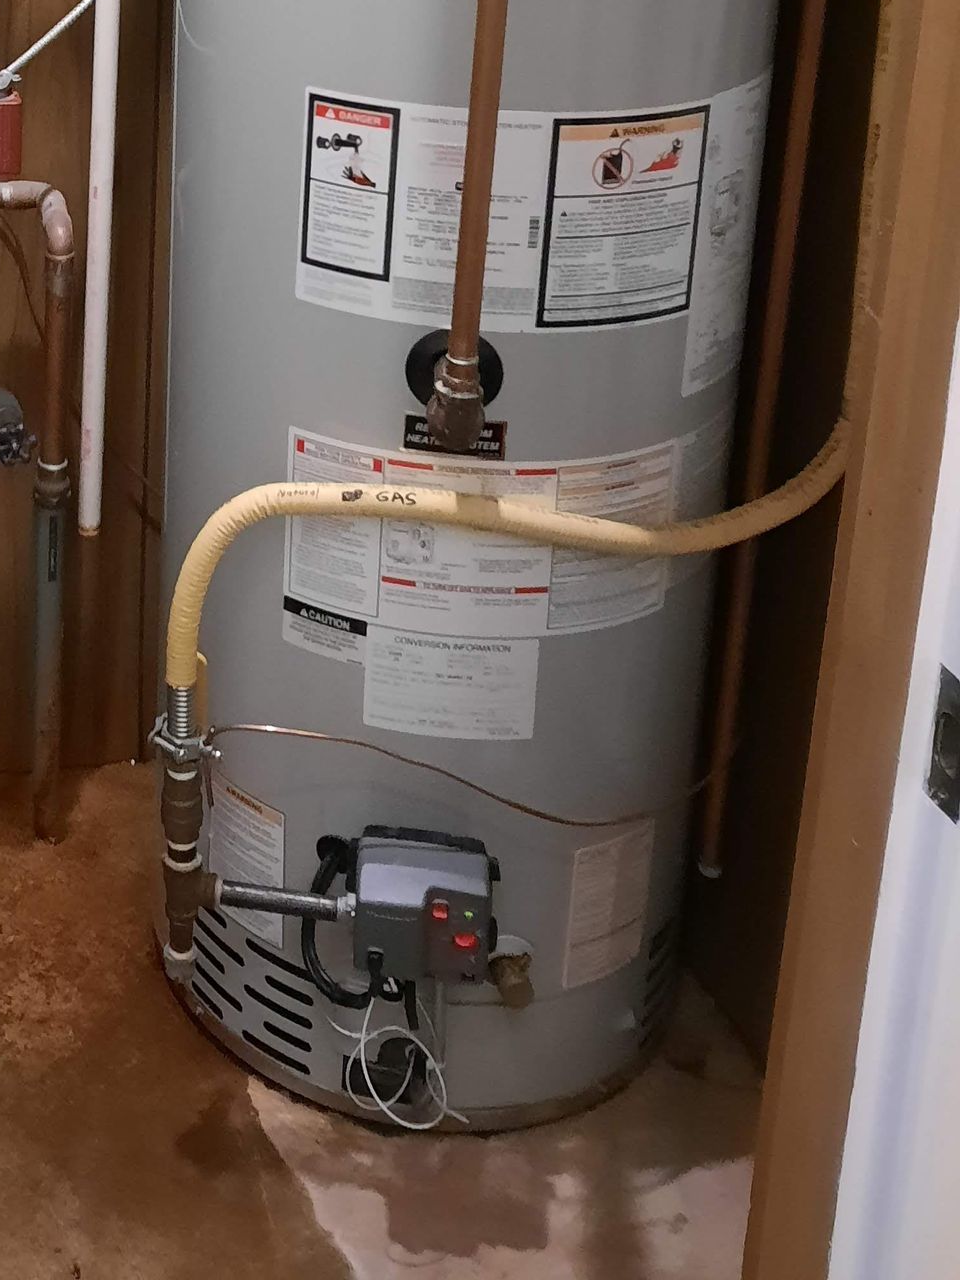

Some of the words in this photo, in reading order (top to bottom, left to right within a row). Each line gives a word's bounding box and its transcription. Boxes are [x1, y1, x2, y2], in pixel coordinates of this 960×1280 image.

[338, 110, 382, 125] DANGER
[622, 124, 666, 136] WARNING
[376, 490, 417, 505] GAS
[309, 609, 351, 632] CAUTION
[394, 635, 450, 650] CONVERSION
[453, 643, 512, 653] INFORMATION
